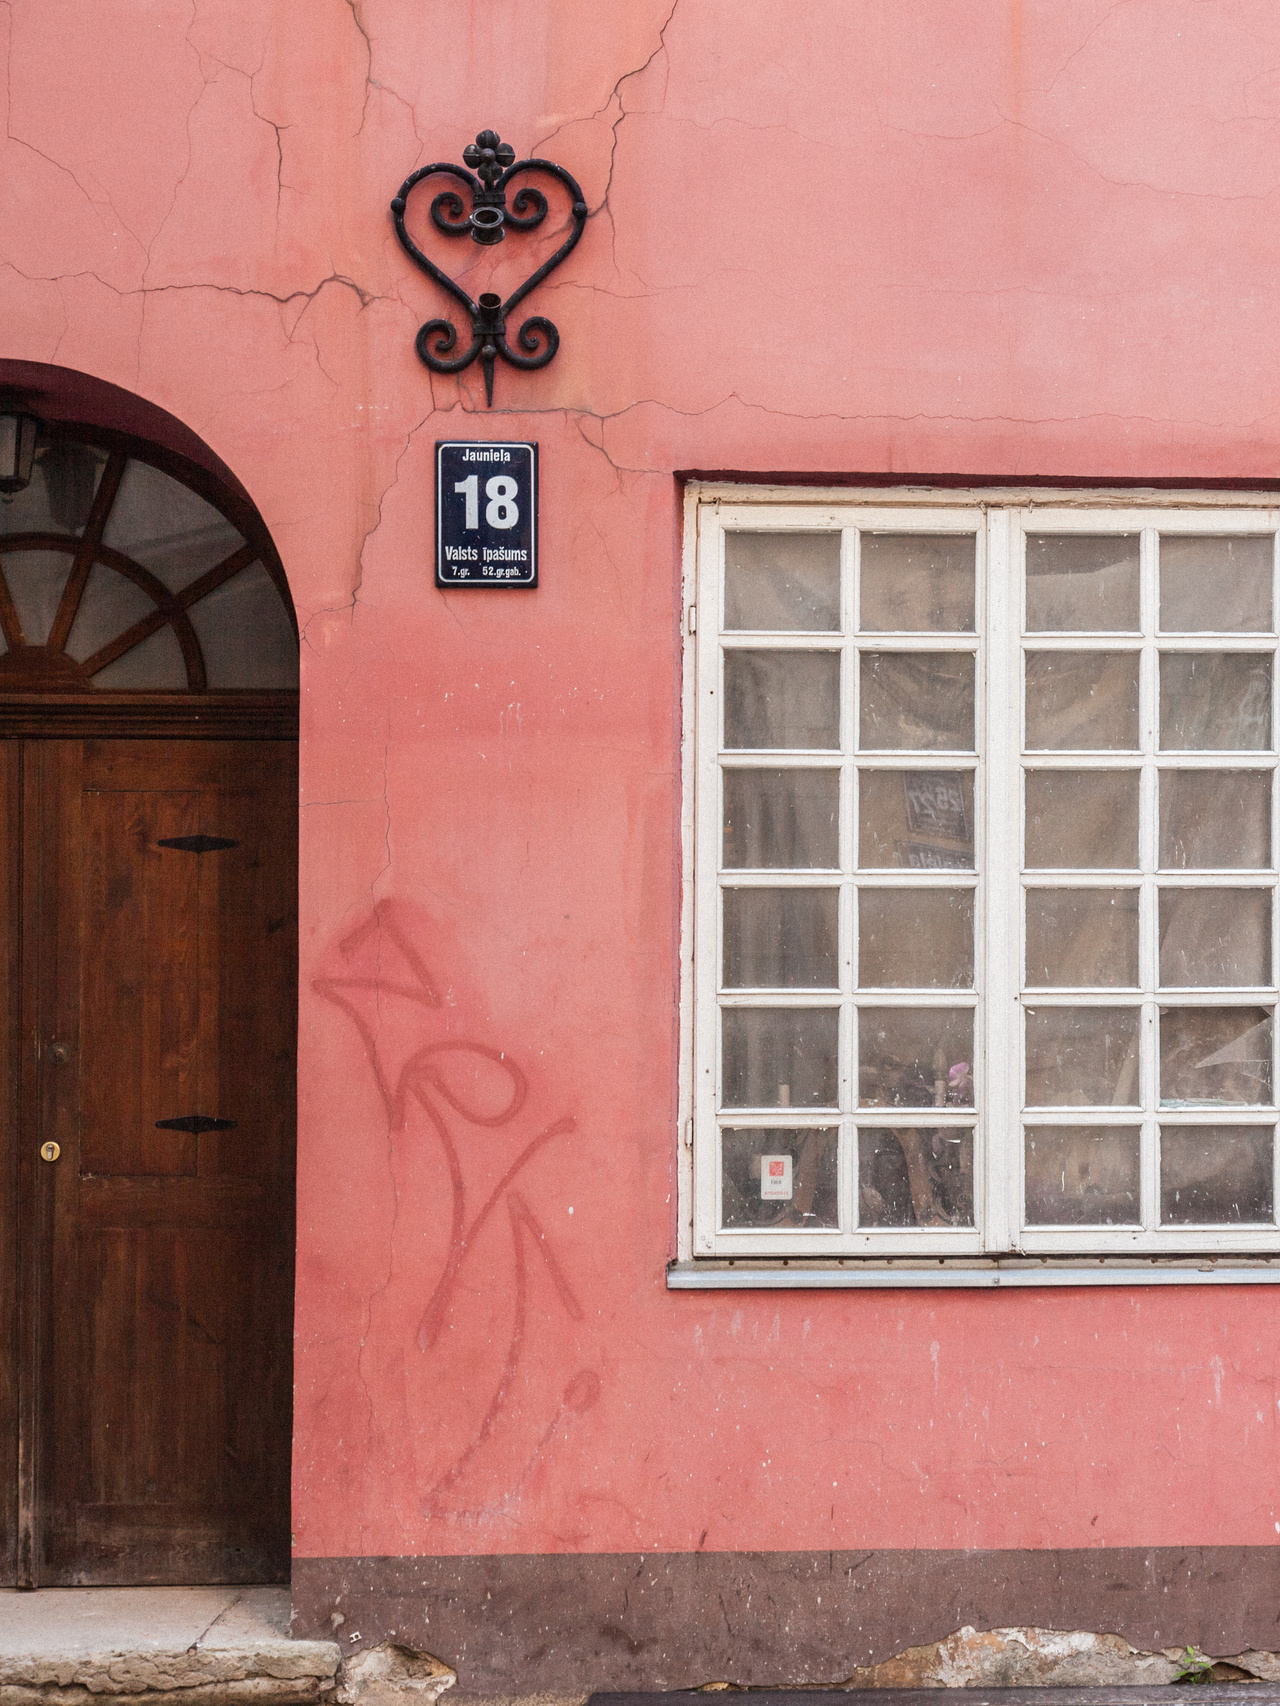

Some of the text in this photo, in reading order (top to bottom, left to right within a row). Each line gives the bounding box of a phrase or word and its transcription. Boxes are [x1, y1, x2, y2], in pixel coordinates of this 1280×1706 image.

[462, 448, 511, 462] Jauniela
[454, 474, 520, 530] 18
[444, 545, 528, 563] Valsts īpašums
